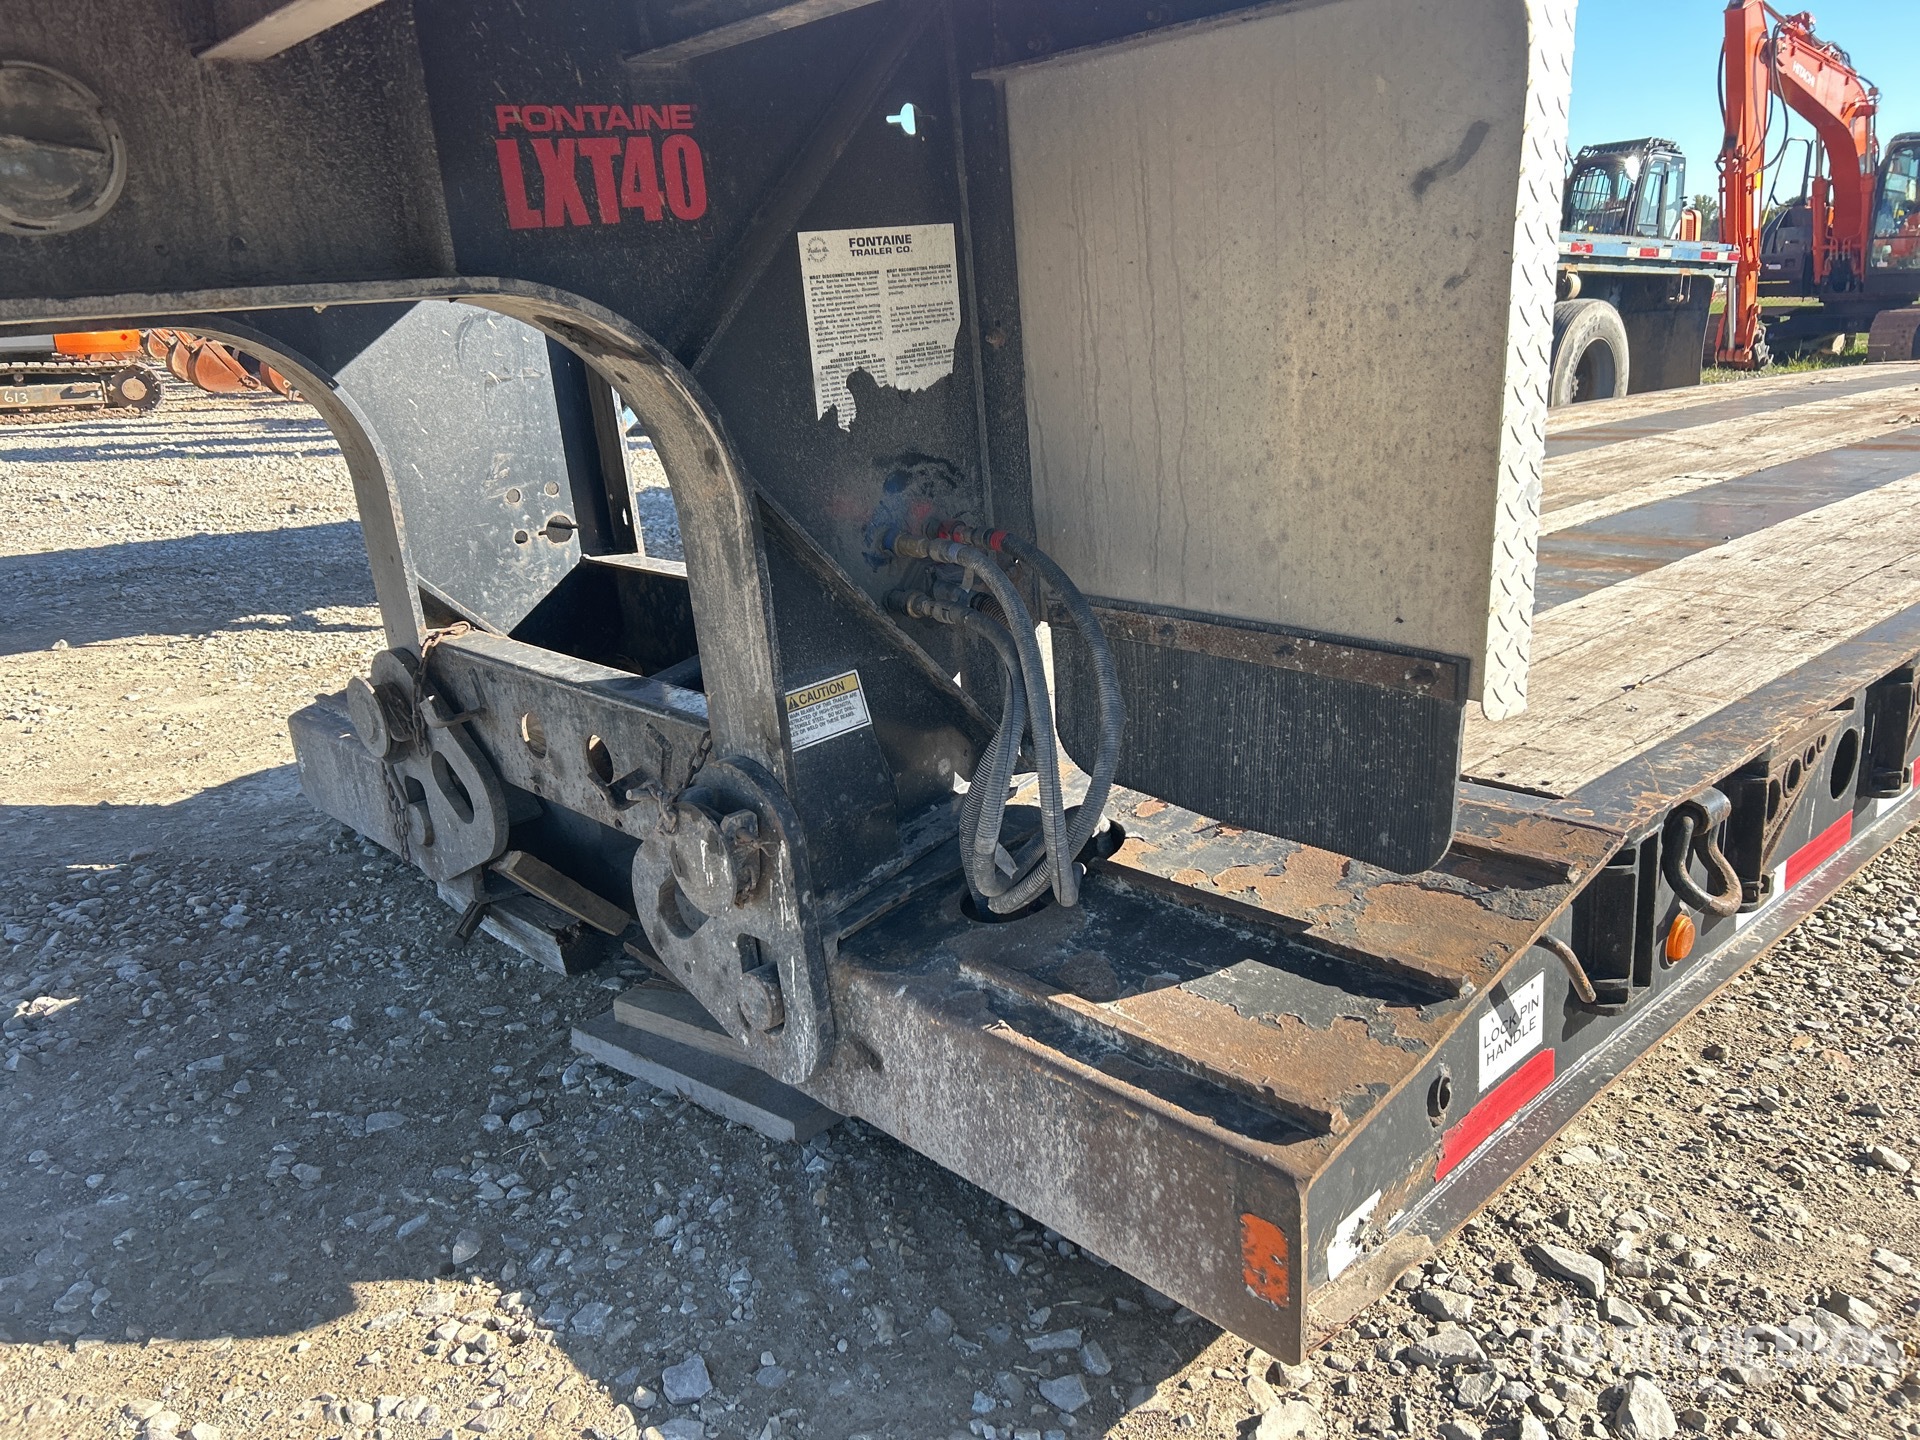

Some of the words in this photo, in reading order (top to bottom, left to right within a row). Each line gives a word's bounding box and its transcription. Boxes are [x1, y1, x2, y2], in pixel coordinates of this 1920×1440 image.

[1792, 61, 1816, 88] HITACHI
[495, 104, 694, 132] FONTAINE
[495, 134, 708, 229] LXT40
[848, 234, 912, 248] FONTAINE
[850, 246, 892, 257] TRAILER
[896, 246, 913, 254] CO.
[4, 391, 28, 404] 613
[798, 680, 845, 704] CAUTION
[1484, 1013, 1516, 1048] LOCK
[1520, 995, 1539, 1019] PIN
[1486, 1016, 1536, 1066] HANDLE
